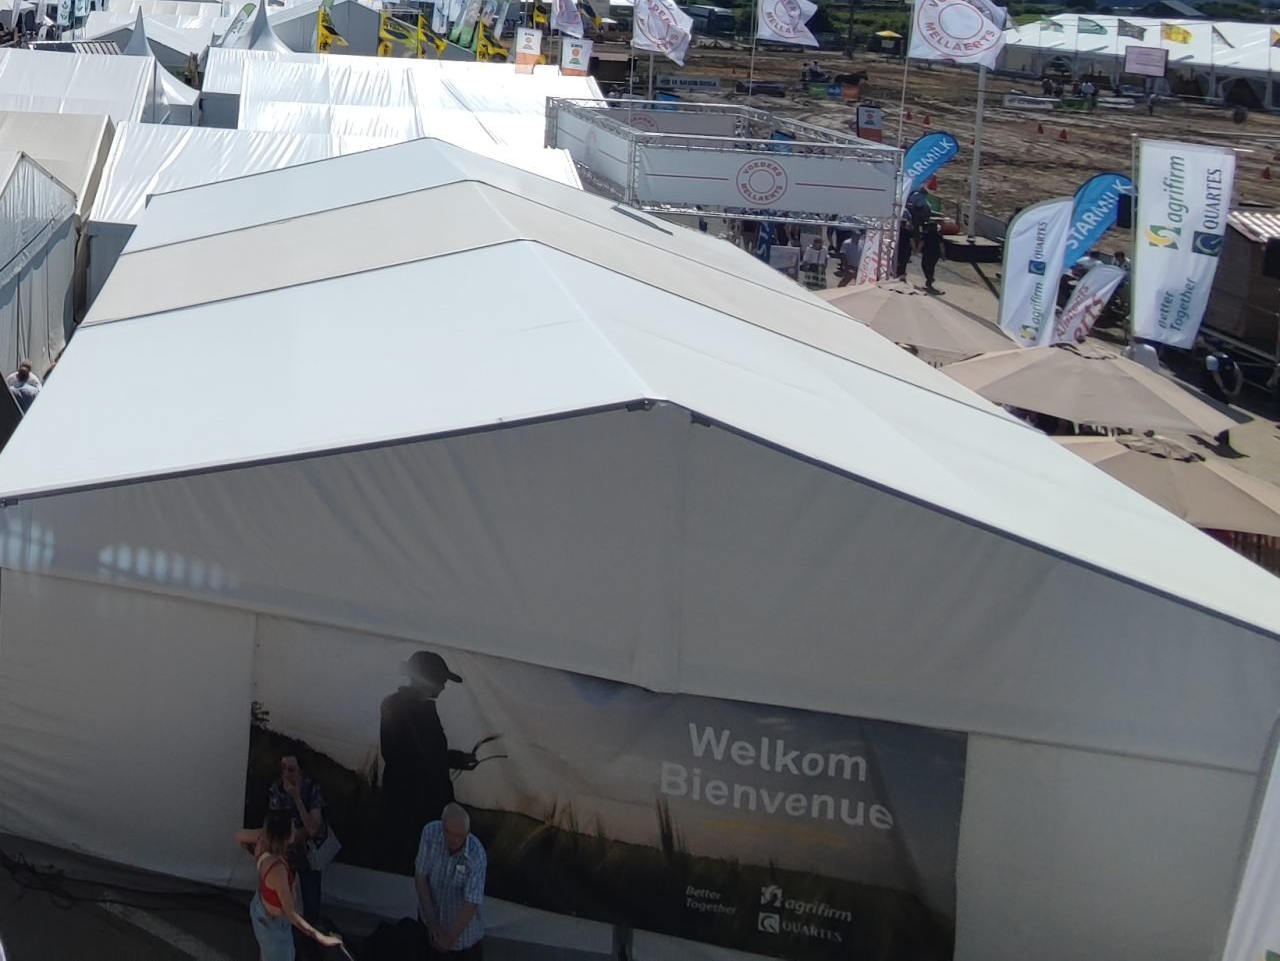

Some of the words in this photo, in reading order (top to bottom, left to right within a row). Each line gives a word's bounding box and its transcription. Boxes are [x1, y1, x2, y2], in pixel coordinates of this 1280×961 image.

[924, 21, 996, 52] MELLAERTS
[742, 161, 783, 177] VOEDERS
[740, 182, 784, 202] MELLAERTS
[1163, 155, 1189, 224] agrifirm
[1203, 168, 1223, 230] QUARTES
[1067, 179, 1133, 250] STARMILK
[1034, 220, 1048, 260] QUARTES
[1029, 281, 1043, 325] agrifirm
[1170, 277, 1197, 333] Together
[688, 721, 867, 782] Welkom
[659, 761, 894, 829] Bienvenue
[685, 885, 721, 900] Better
[685, 897, 737, 915] Together
[784, 896, 852, 923] agrifirm
[782, 920, 843, 943] QUARTES
